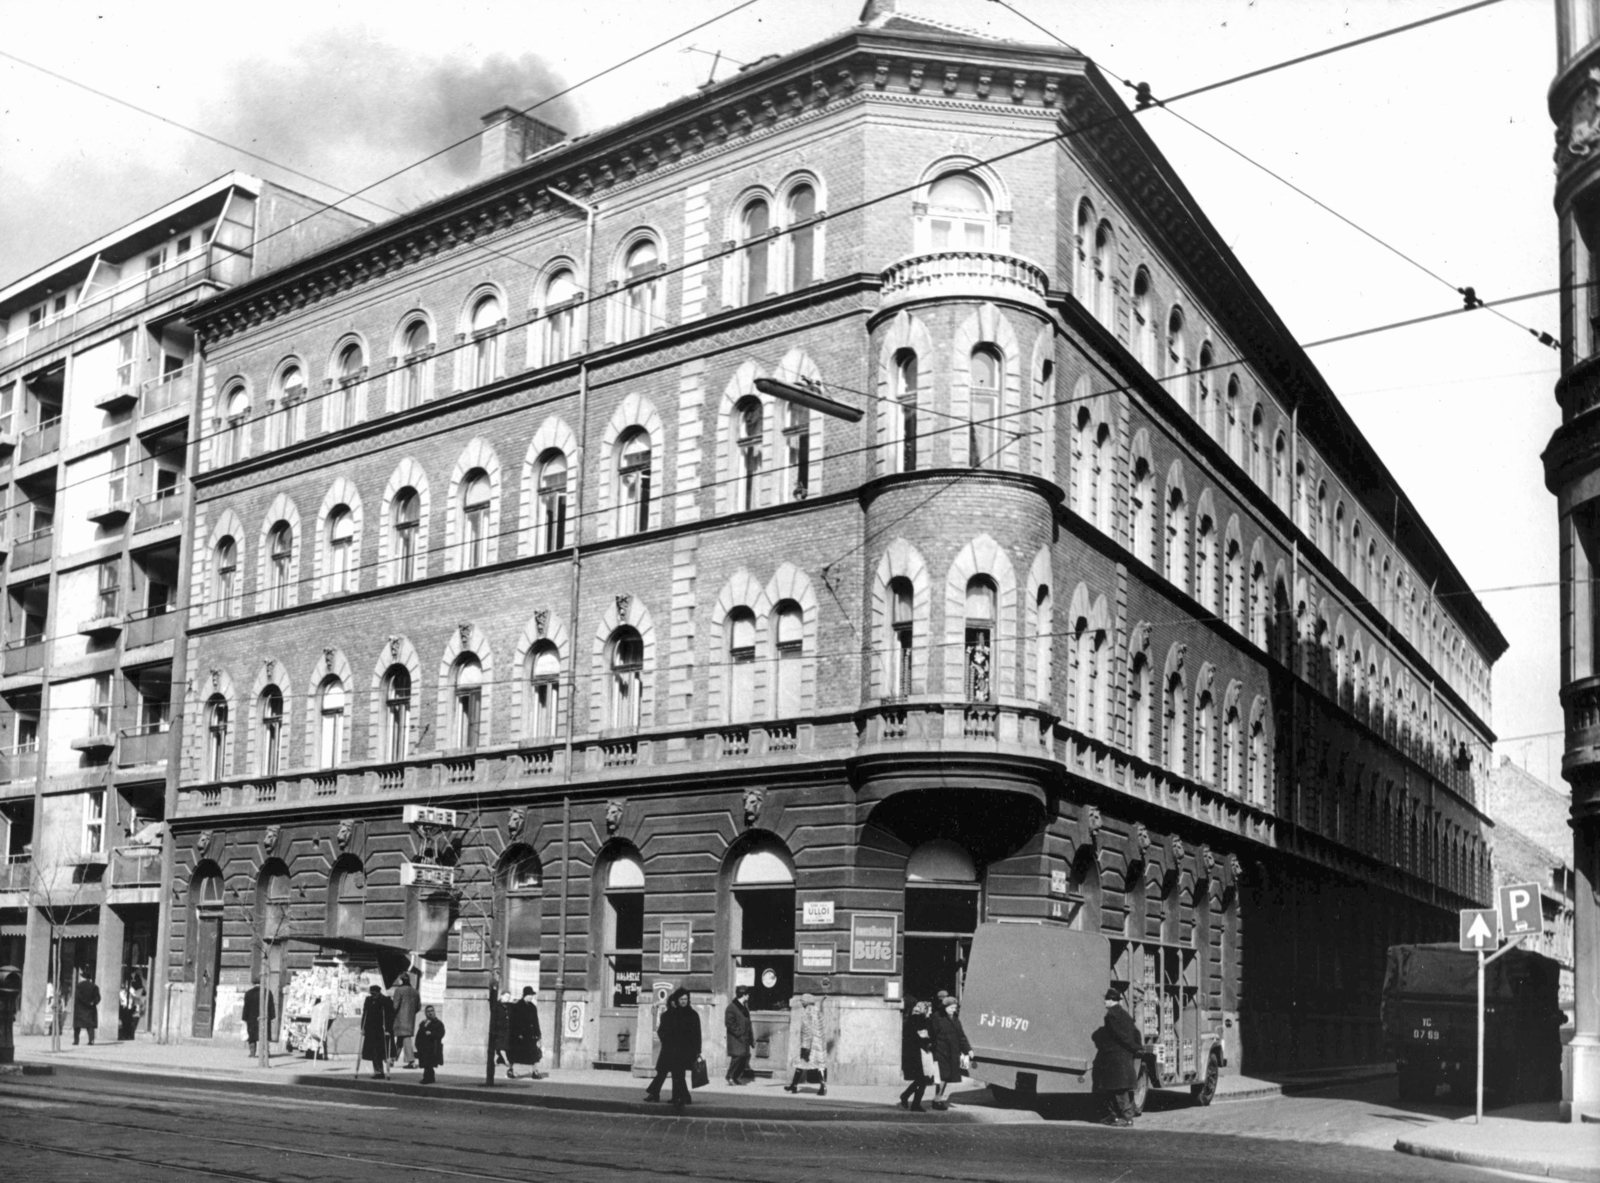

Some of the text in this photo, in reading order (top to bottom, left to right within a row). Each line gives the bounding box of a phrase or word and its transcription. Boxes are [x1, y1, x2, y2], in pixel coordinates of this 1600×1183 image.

[1509, 889, 1531, 922] P
[462, 940, 482, 952] Büfé
[663, 938, 688, 952] Büfé
[855, 940, 892, 960] Büfé
